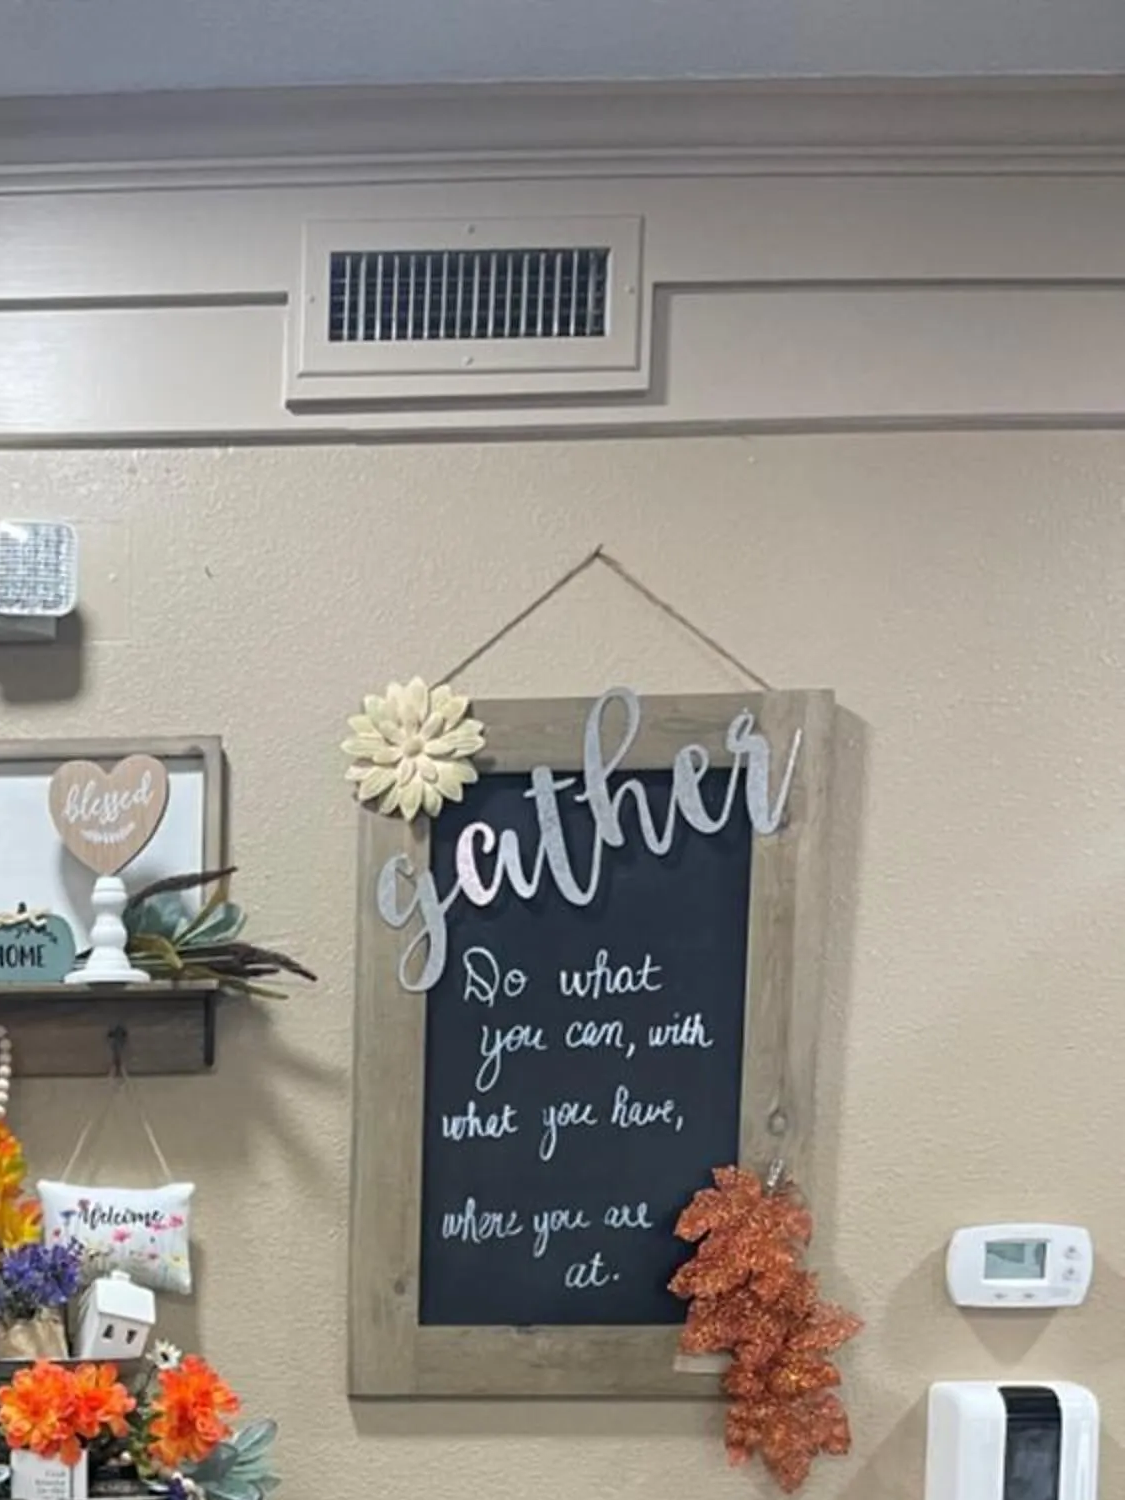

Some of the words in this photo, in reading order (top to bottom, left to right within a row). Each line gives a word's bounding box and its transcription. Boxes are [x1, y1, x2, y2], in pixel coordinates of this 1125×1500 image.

[62, 770, 155, 824] blessed
[378, 687, 802, 992] gather
[463, 947, 527, 1005] Do
[560, 950, 662, 999] what
[476, 1023, 548, 1091] you
[566, 1019, 635, 1059] can,
[648, 1013, 713, 1048] with
[442, 1104, 518, 1143] what
[543, 1102, 597, 1160] you
[612, 1086, 684, 1132] have,
[442, 1198, 523, 1245] where
[533, 1209, 589, 1255] you
[605, 1205, 652, 1230] are
[565, 1256, 619, 1288] at.
